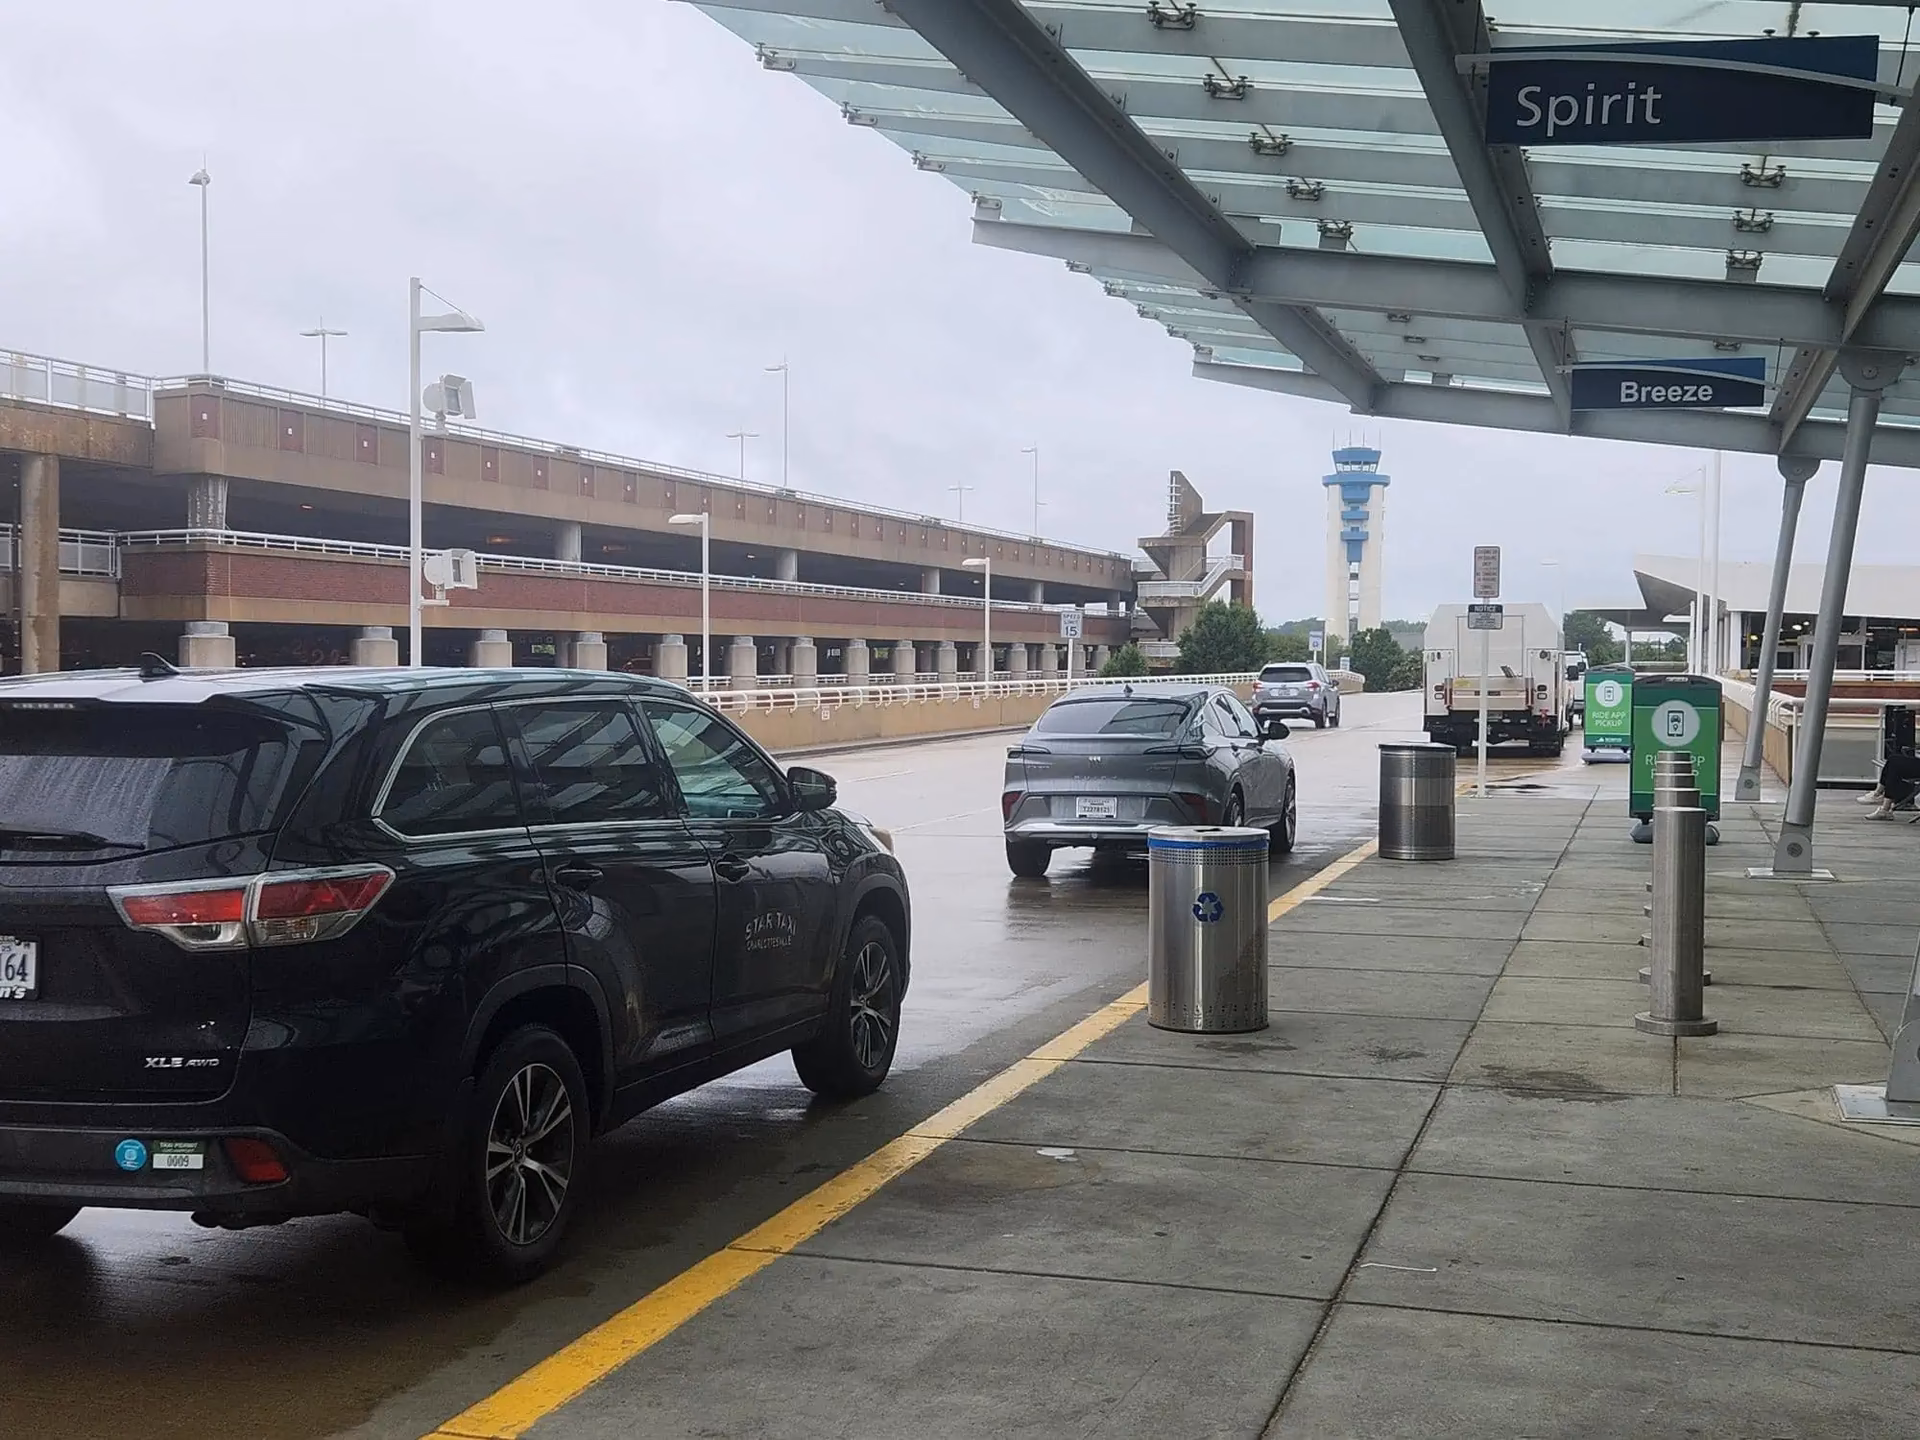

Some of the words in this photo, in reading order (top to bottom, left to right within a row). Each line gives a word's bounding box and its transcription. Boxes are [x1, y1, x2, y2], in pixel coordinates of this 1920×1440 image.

[1515, 81, 1662, 137] Spirit
[1620, 381, 1714, 404] Breeze
[1065, 626, 1078, 636] 15
[1592, 711, 1609, 719] RIDE
[1611, 711, 1626, 719] APP
[1595, 719, 1623, 727] PICKUP
[745, 912, 773, 940] STAR
[776, 912, 797, 936] TAXI
[144, 1057, 184, 1068] XLE
[185, 1058, 220, 1067] AWD
[166, 1155, 190, 1167] 0009
